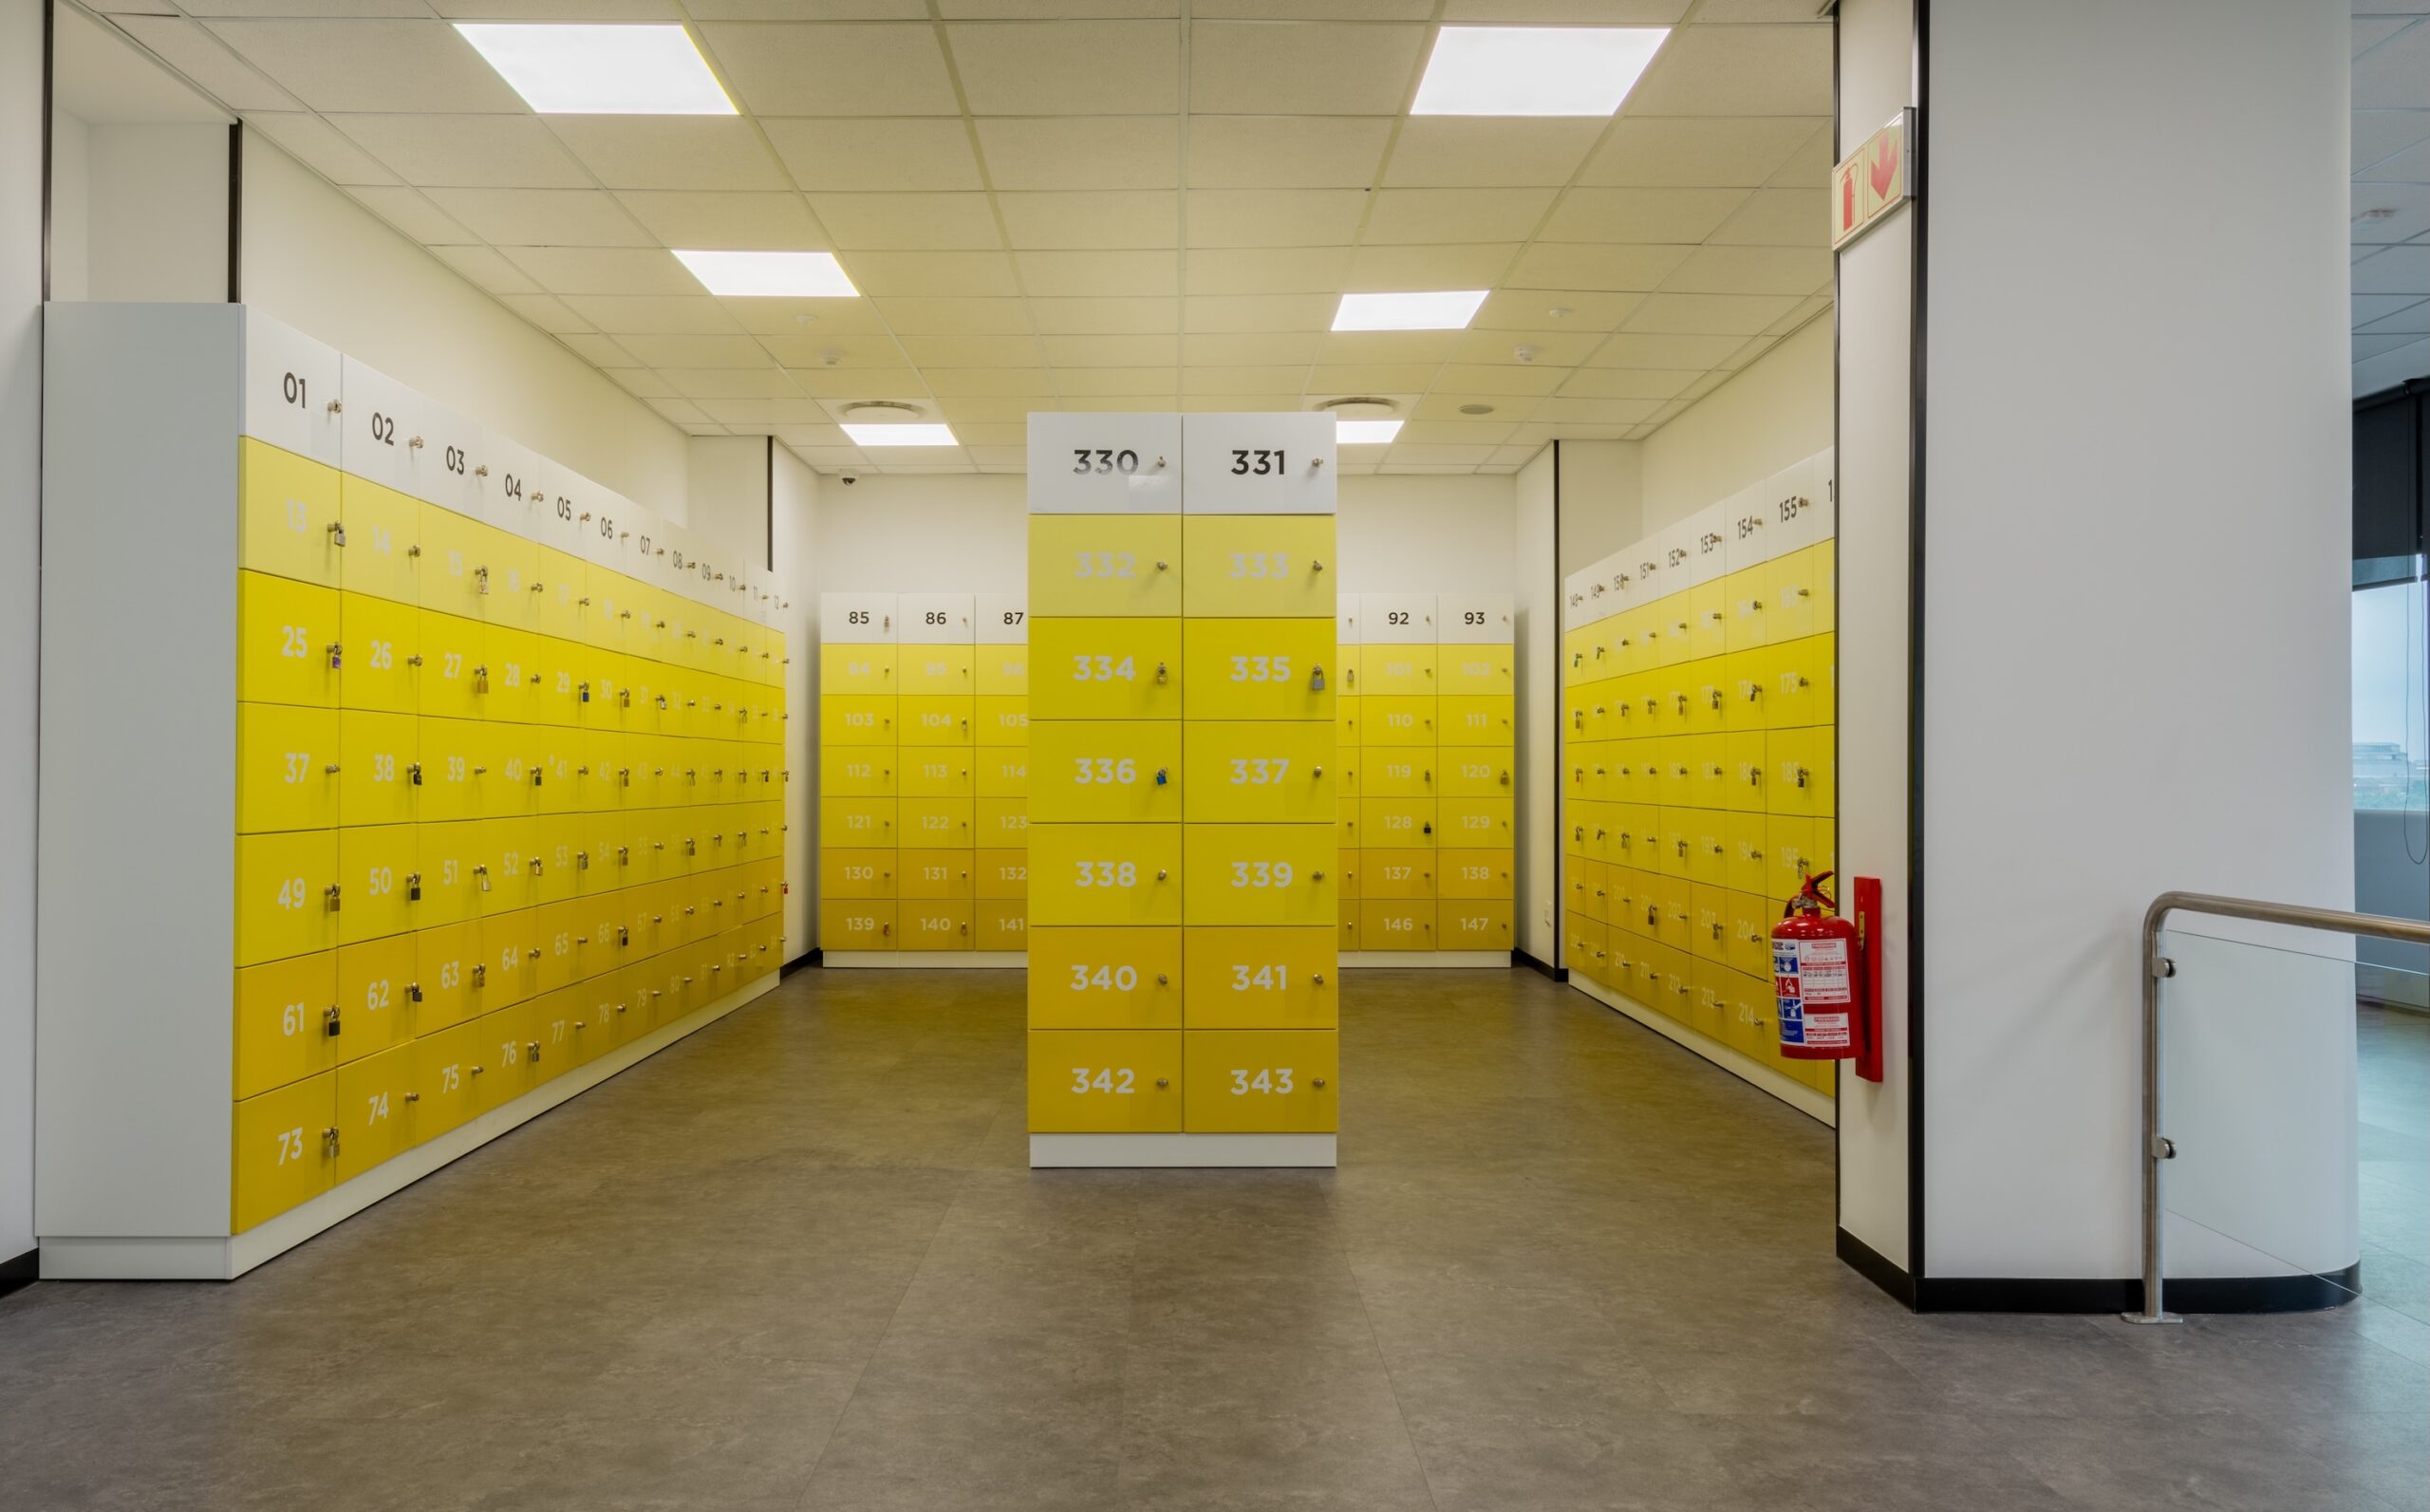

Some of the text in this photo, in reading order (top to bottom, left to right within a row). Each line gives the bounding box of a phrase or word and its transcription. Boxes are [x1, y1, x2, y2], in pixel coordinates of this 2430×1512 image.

[283, 372, 306, 408] 01
[372, 412, 394, 446] 02
[446, 445, 464, 475] 03
[1074, 449, 1138, 475] 330
[1231, 450, 1285, 475] 331
[505, 474, 521, 501] 04
[557, 496, 571, 521] 05
[1779, 495, 1797, 523] 155
[601, 517, 612, 539] 06
[1738, 515, 1753, 540] 154
[640, 535, 650, 555] 07
[1700, 532, 1713, 554] 153
[673, 551, 682, 569] 08
[1075, 552, 1136, 578] 332
[1229, 552, 1289, 578] 333
[1668, 549, 1680, 569] 152
[701, 564, 711, 581] 09
[849, 611, 869, 625] 85
[925, 612, 946, 625] 86
[1003, 612, 1024, 625] 87
[1388, 611, 1410, 625] 92
[1464, 611, 1485, 625] 93
[282, 625, 308, 658] 25
[371, 640, 392, 670] 26
[443, 652, 462, 680] 27
[505, 663, 520, 688] 28
[1073, 655, 1136, 681] 334
[1230, 656, 1291, 681] 335
[556, 671, 570, 693] 29
[601, 680, 611, 699] 30
[1780, 670, 1798, 695] 175
[845, 714, 874, 727] 103
[921, 714, 952, 727] 104
[999, 714, 1028, 727] 105
[1388, 714, 1413, 727] 110
[1467, 714, 1486, 727] 111
[285, 753, 309, 784] 37
[373, 754, 395, 782] 38
[447, 756, 465, 782] 39
[505, 758, 522, 782] 40
[556, 759, 569, 780] 41
[847, 765, 871, 778] 112
[923, 765, 947, 778] 113
[1002, 765, 1026, 778] 114
[1075, 758, 1136, 784] 336
[1230, 759, 1290, 784] 337
[1387, 765, 1411, 778] 119
[1461, 765, 1490, 778] 120
[847, 816, 871, 829] 121
[922, 816, 949, 830] 122
[1000, 816, 1028, 830] 123
[1384, 816, 1412, 829] 128
[1461, 816, 1490, 829] 129
[504, 851, 519, 876] 52
[555, 844, 568, 867] 53
[368, 867, 392, 895] 50
[443, 859, 458, 886] 51
[845, 867, 874, 880] 130
[923, 868, 947, 880] 131
[1000, 868, 1027, 880] 132
[1075, 862, 1137, 887] 338
[1231, 862, 1293, 887] 339
[1384, 867, 1411, 880] 137
[1461, 867, 1489, 880] 138
[277, 878, 306, 910] 49
[598, 923, 610, 943] 66
[846, 918, 875, 931] 139
[921, 918, 951, 931] 140
[999, 918, 1024, 931] 141
[1383, 918, 1413, 931] 146
[1460, 918, 1488, 931] 147
[1737, 919, 1754, 941] 204
[555, 933, 569, 956] 65
[502, 946, 518, 971] 64
[440, 961, 459, 990] 63
[1070, 965, 1138, 990] 340
[1231, 965, 1287, 990] 341
[367, 980, 389, 1011] 62
[637, 987, 646, 1007] 79
[283, 1002, 305, 1036] 61
[598, 1002, 609, 1024] 78
[1738, 1001, 1754, 1026] 214
[551, 1019, 565, 1044] 77
[501, 1041, 516, 1068] 76
[441, 1064, 459, 1093] 75
[1071, 1068, 1135, 1093] 342
[1230, 1069, 1293, 1095] 343
[368, 1095, 389, 1126] 74
[277, 1128, 304, 1166] 73
